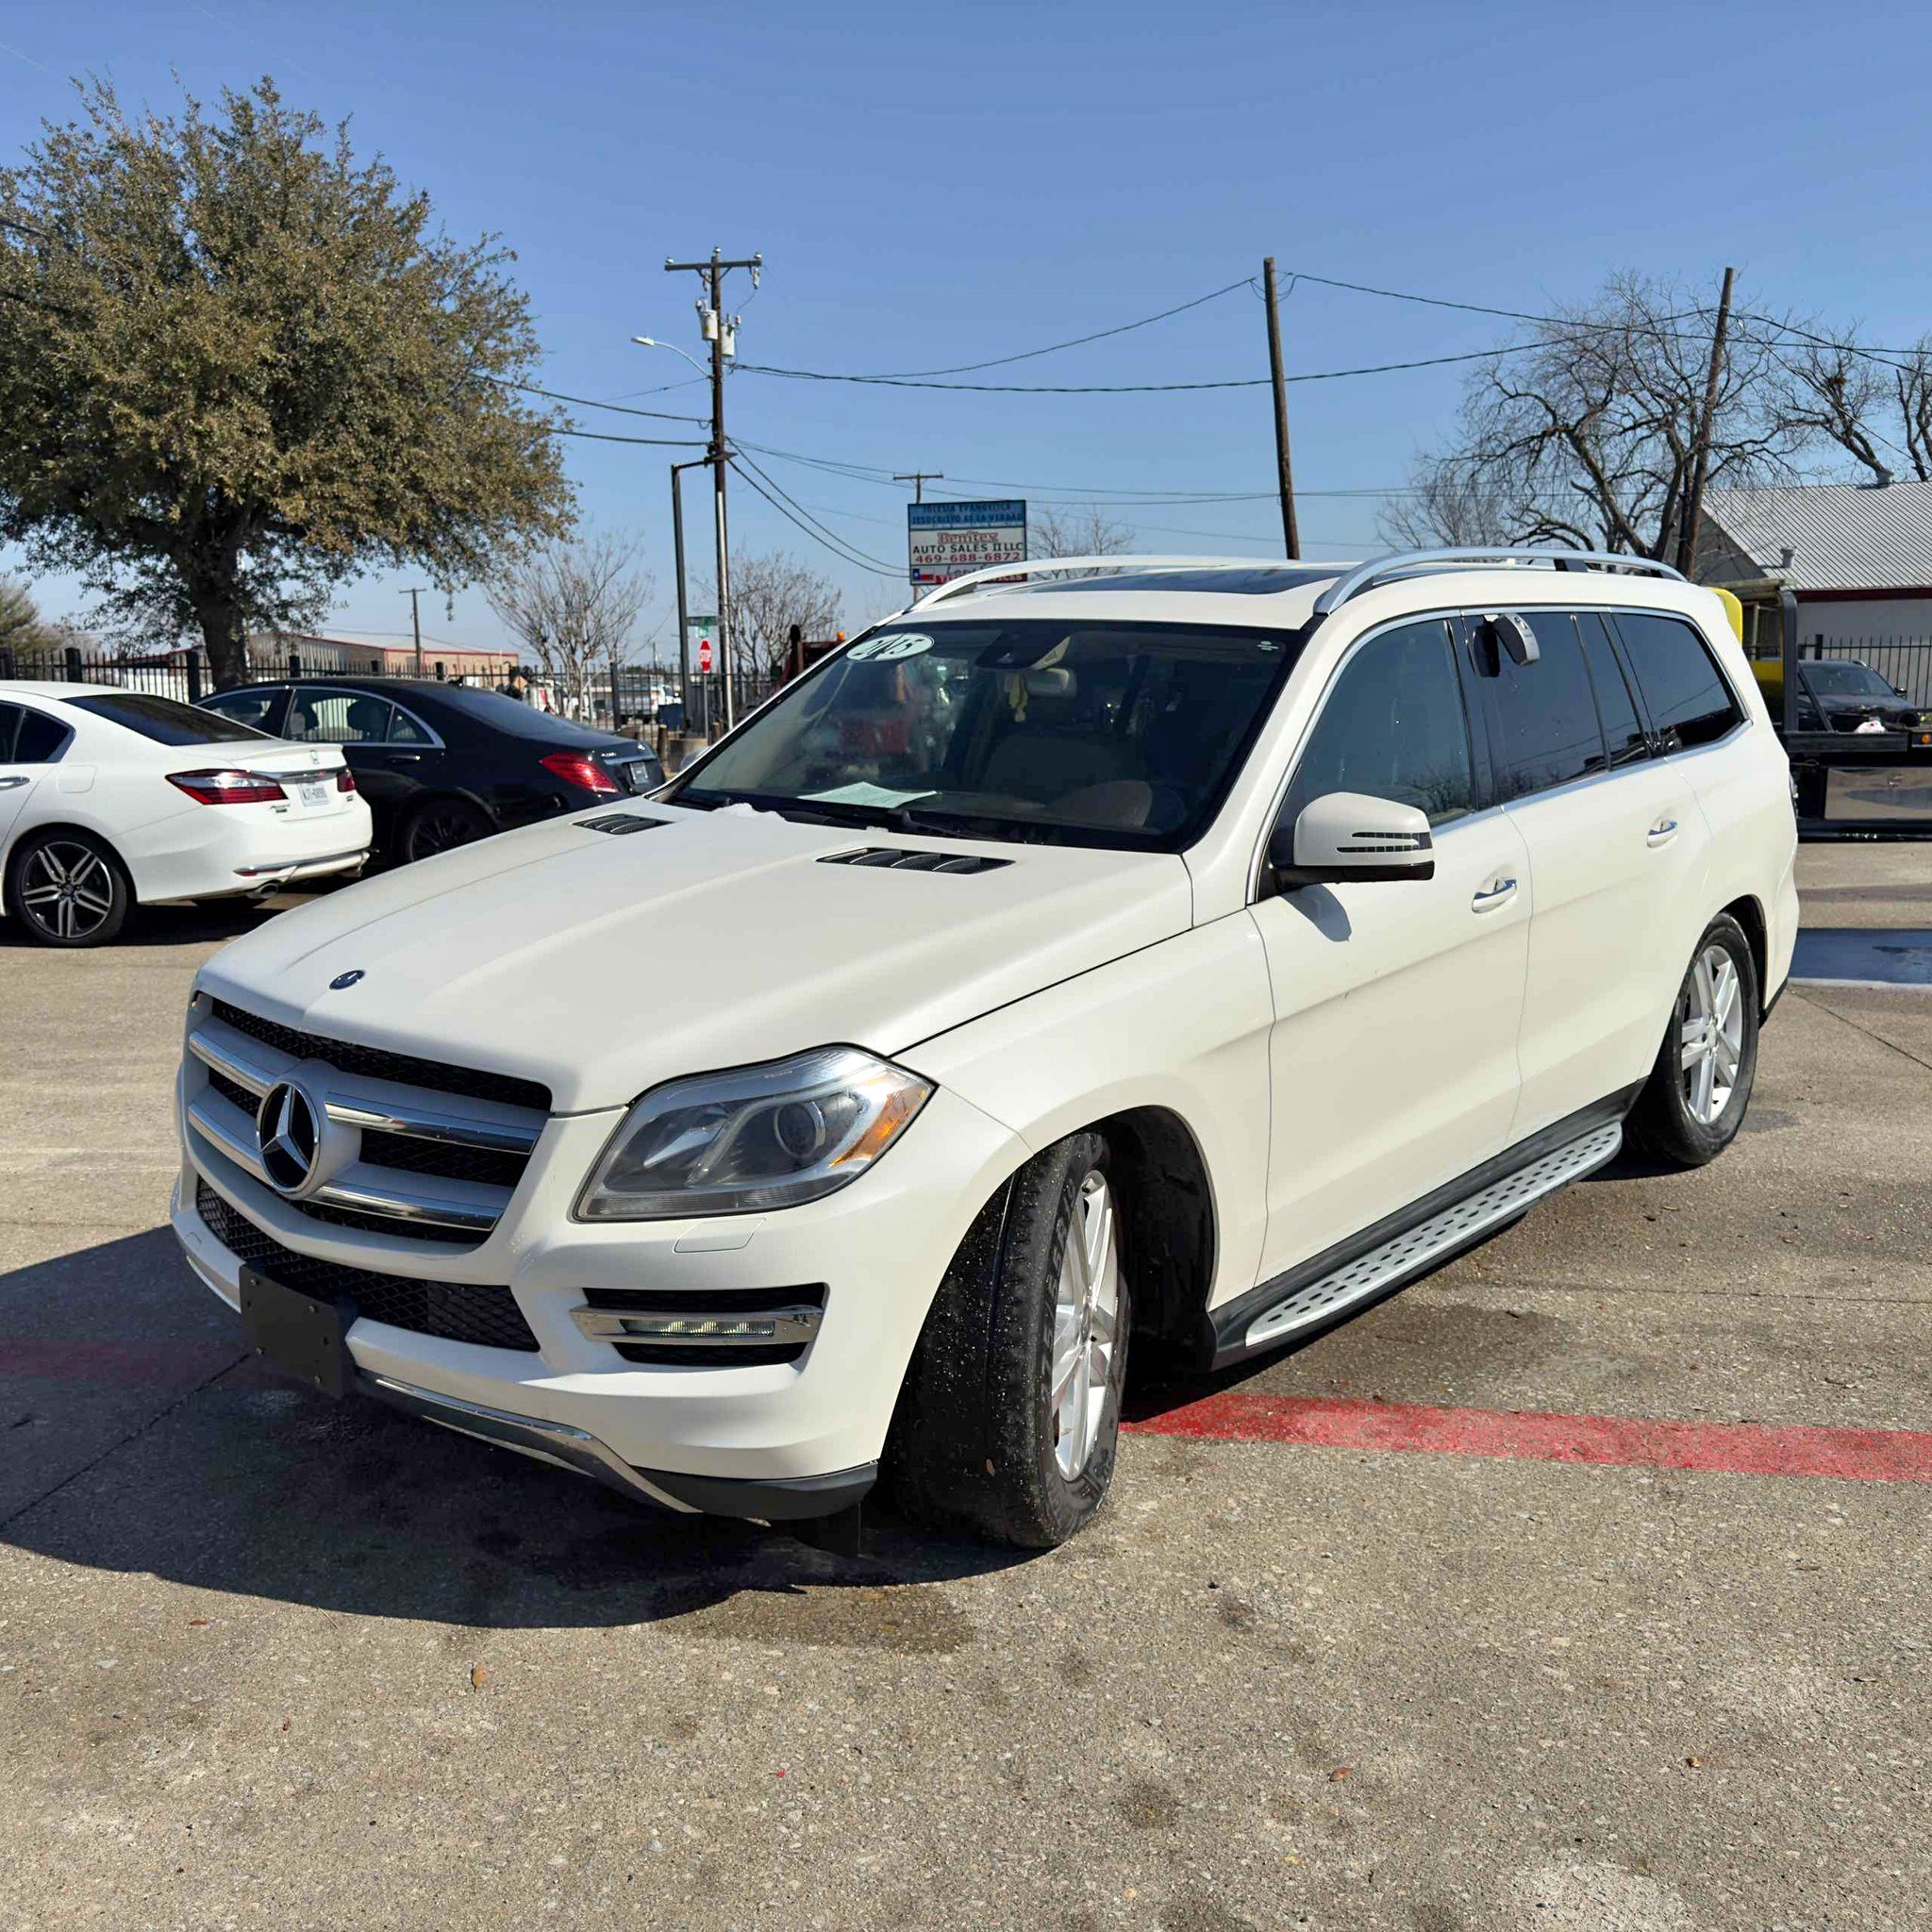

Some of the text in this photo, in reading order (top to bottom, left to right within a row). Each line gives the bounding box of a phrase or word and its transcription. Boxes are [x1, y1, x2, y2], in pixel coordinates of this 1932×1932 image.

[913, 544, 945, 554] AUTO
[950, 543, 988, 553] SALES
[915, 552, 1020, 563] 469-688-6872
